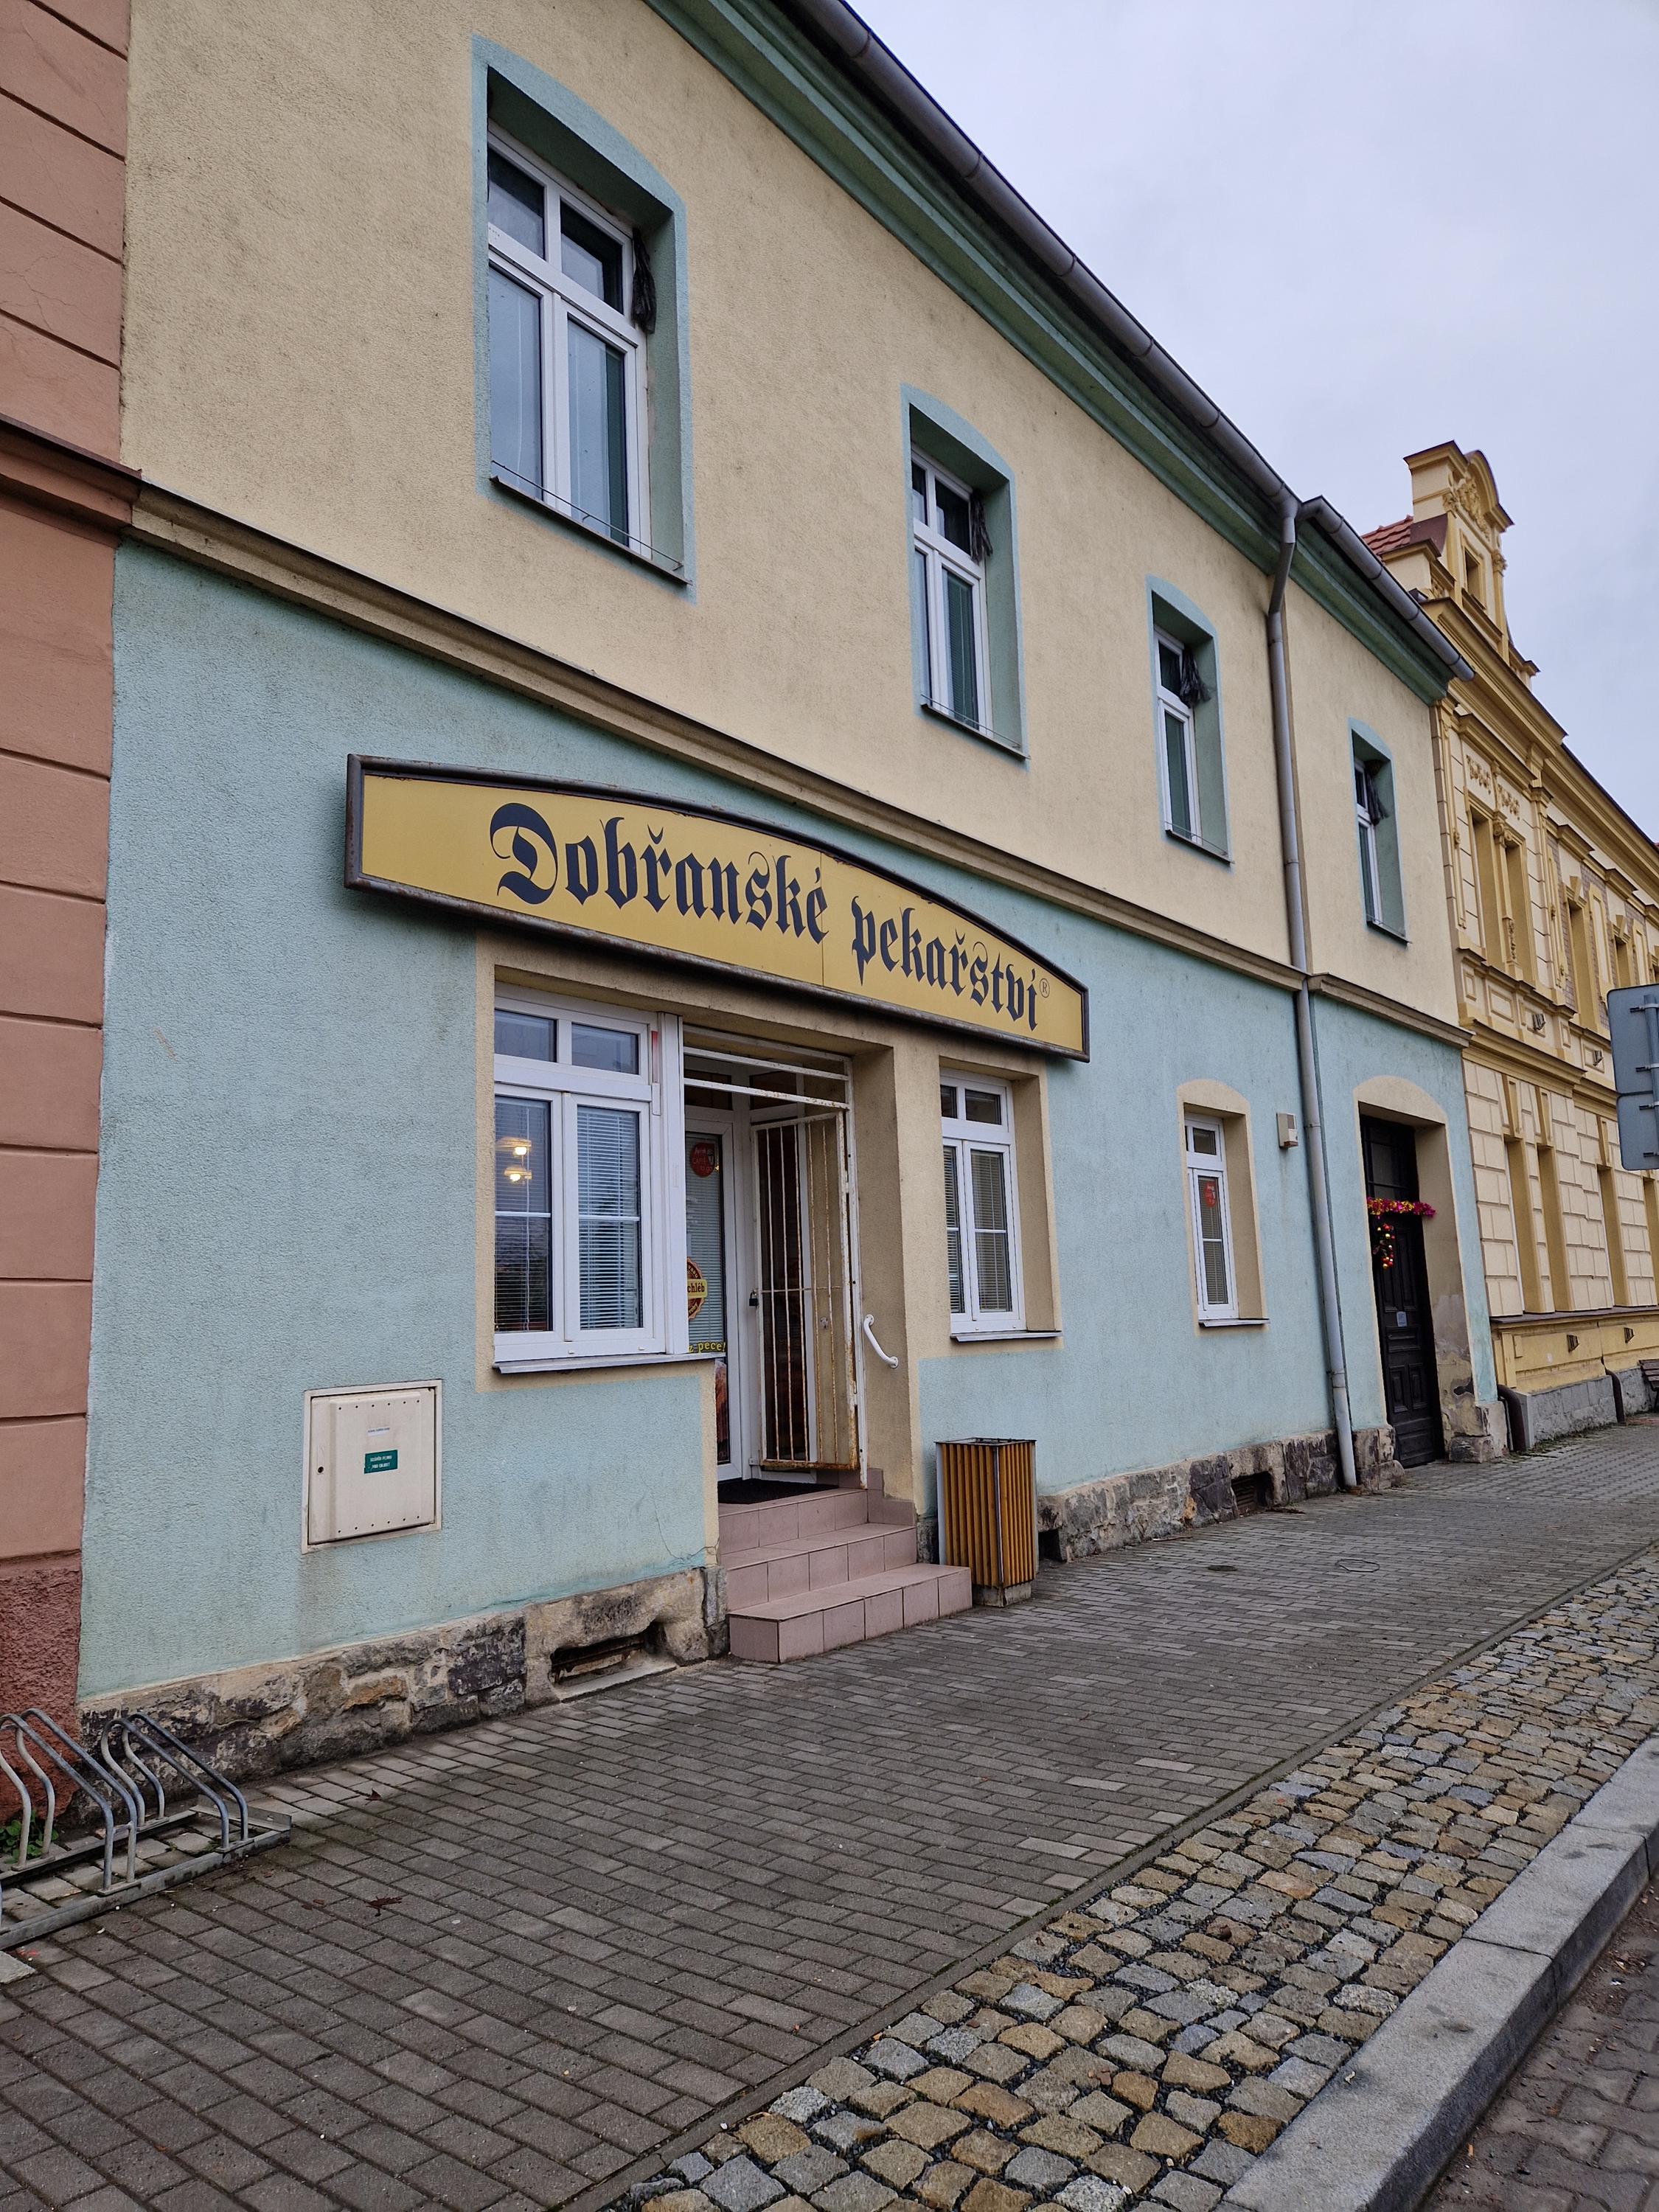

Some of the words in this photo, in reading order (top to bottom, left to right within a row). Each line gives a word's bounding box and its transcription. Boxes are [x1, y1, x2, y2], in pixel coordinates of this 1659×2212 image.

[490, 802, 830, 945] Dobřanské
[686, 1282, 705, 1293] chléb
[697, 1342, 726, 1354] pece!
